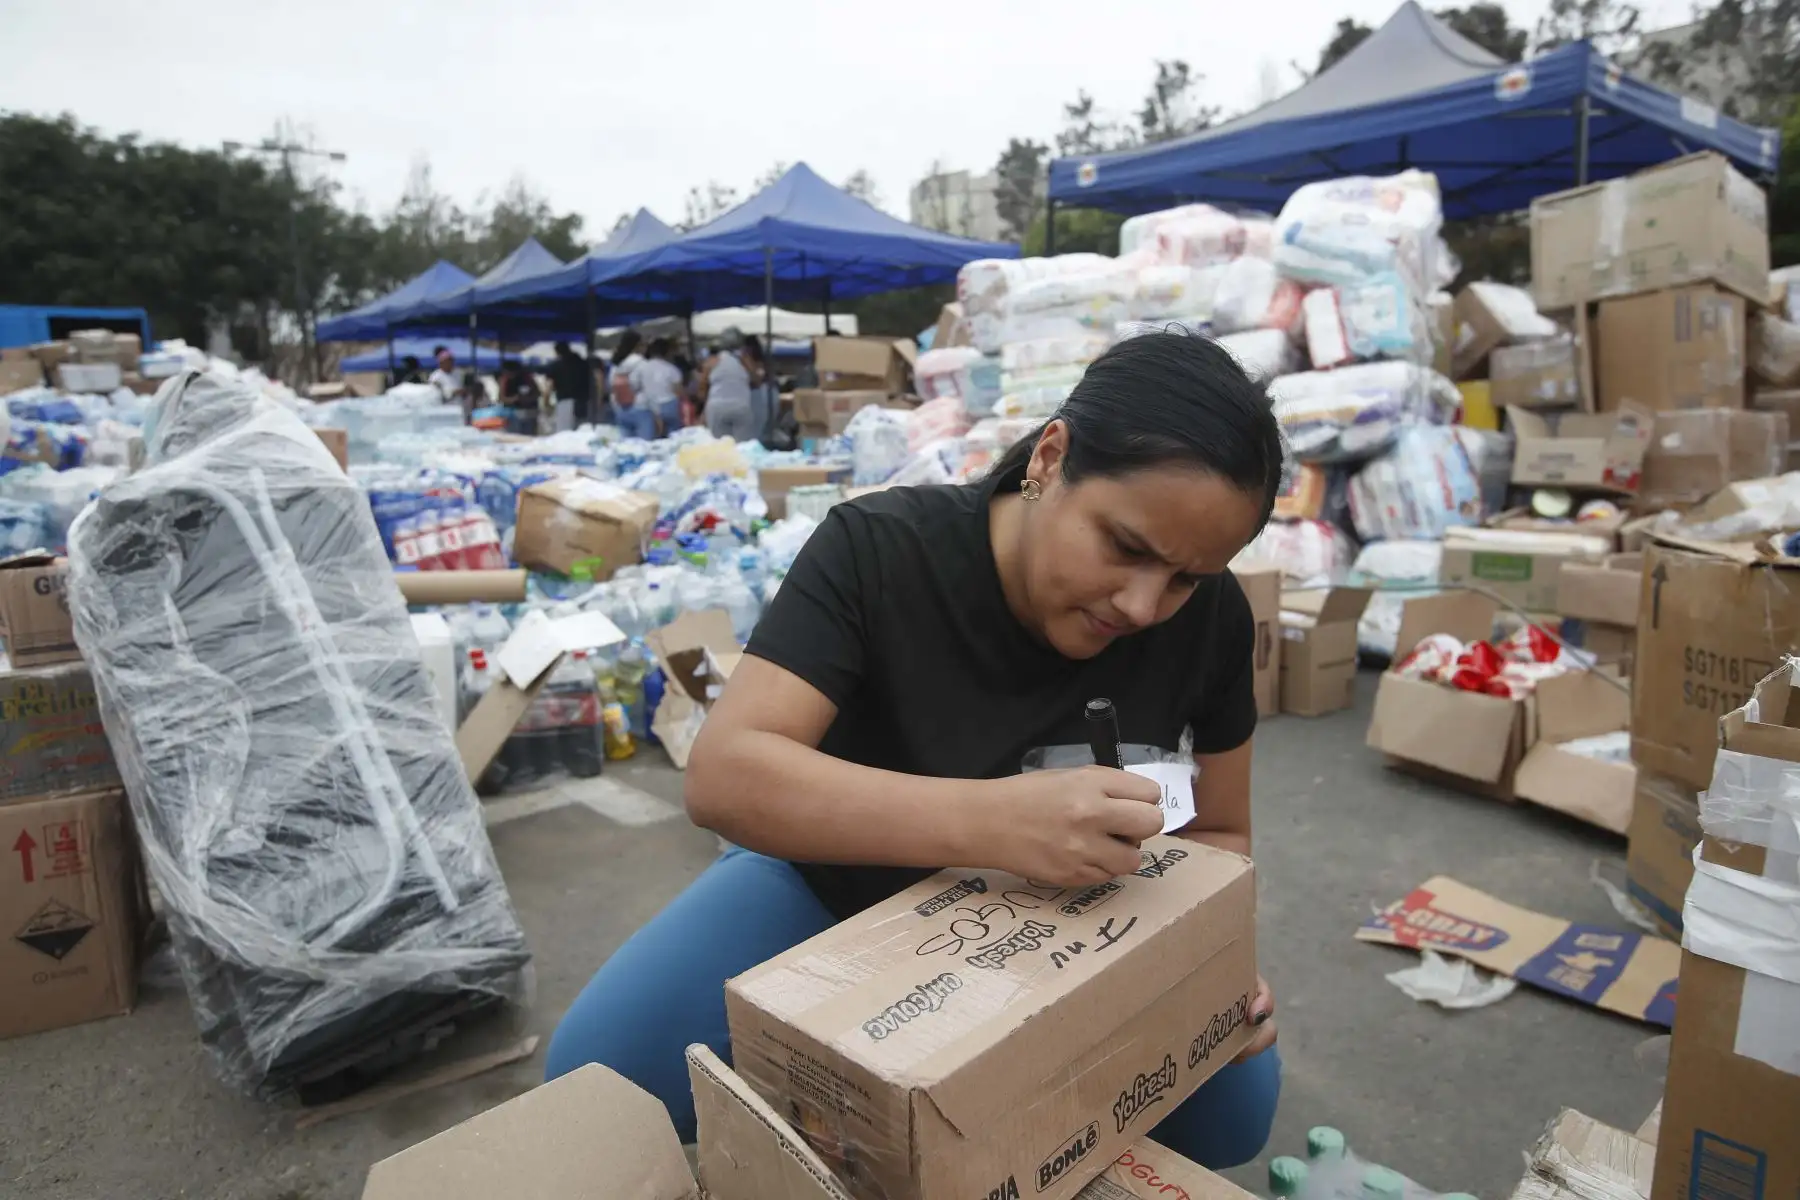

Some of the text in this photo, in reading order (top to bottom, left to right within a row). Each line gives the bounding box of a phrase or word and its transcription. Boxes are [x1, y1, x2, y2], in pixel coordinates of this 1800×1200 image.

[1684, 645, 1740, 684] SG716
[1131, 848, 1189, 879] GLORIA
[926, 889, 968, 915] SIX PACK
[965, 919, 1057, 969] Yofresh
[862, 973, 963, 1040] CHICOLAC
[1188, 993, 1248, 1070] CHICOLAC
[1113, 1053, 1177, 1134] Yofresh
[981, 1174, 1021, 1200] RIA
